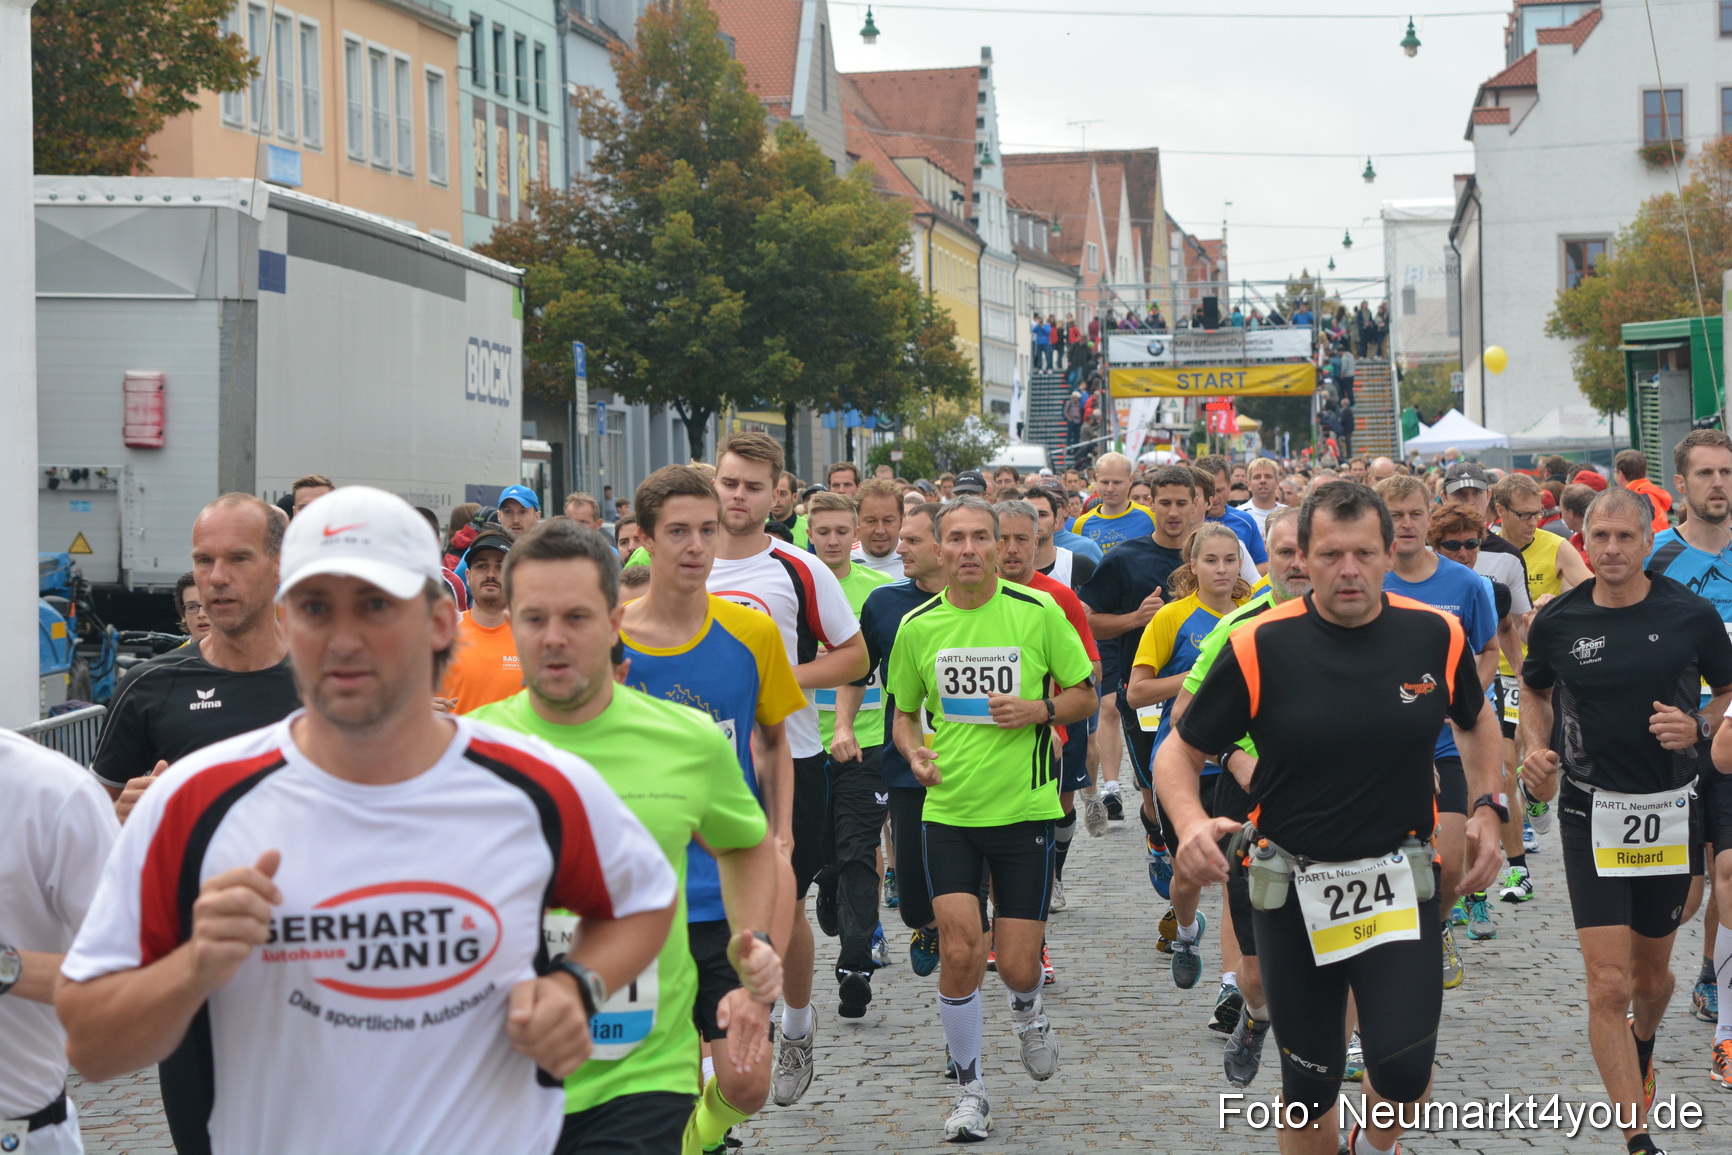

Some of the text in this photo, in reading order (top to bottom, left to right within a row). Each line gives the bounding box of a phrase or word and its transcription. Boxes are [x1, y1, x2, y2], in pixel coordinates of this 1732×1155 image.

[466, 337, 511, 406] BOCK
[1177, 372, 1247, 389] START
[936, 654, 1006, 664] PARTL Neumarkt
[943, 665, 1014, 695] 3350
[189, 700, 222, 710] erima
[1595, 800, 1672, 812] PARTL Neumarkt
[1623, 813, 1661, 845] 20
[1617, 850, 1664, 865] Richard
[1297, 871, 1335, 886] PARTL
[1323, 872, 1396, 922] 224
[1353, 919, 1378, 941] Sigi
[288, 980, 497, 1032] Das sportliche Autohaus
